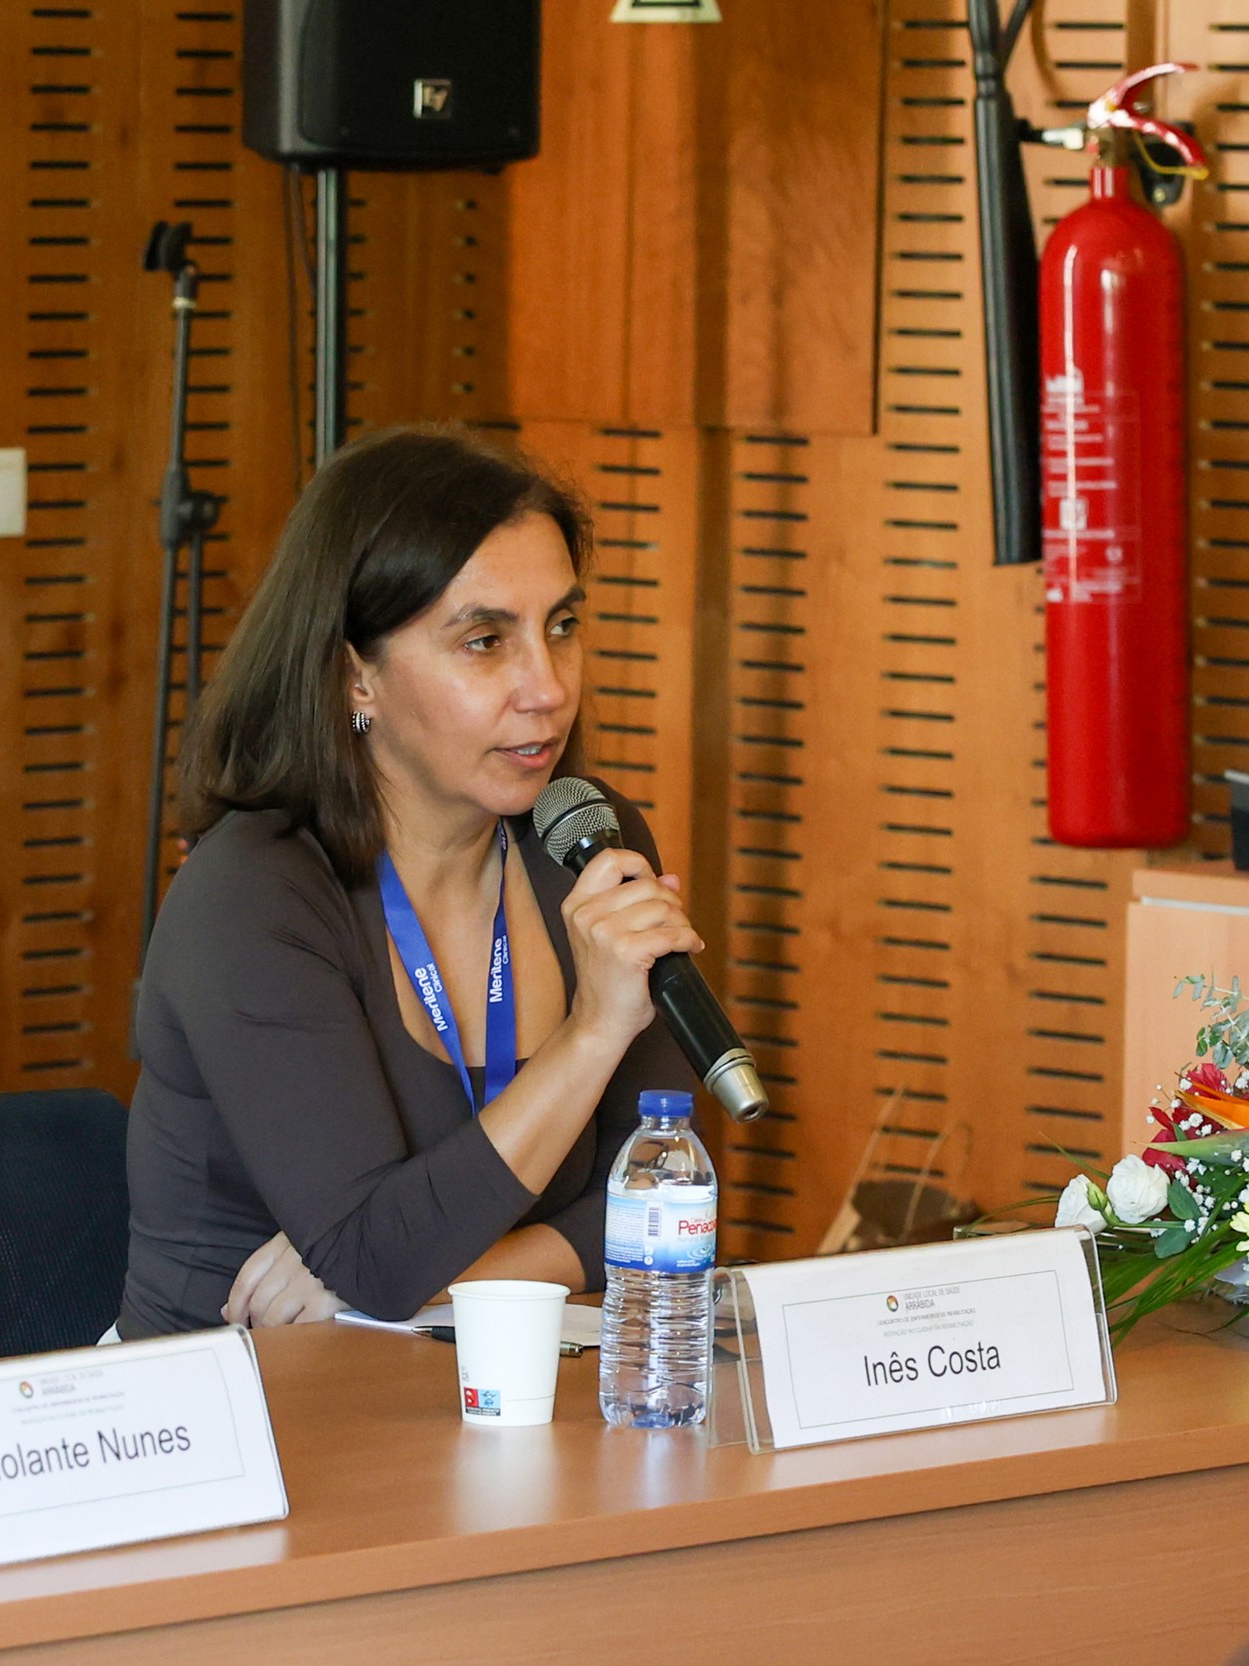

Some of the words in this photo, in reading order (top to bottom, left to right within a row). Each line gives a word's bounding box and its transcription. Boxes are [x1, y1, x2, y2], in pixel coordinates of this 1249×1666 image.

[426, 963, 443, 992] Clinical
[489, 938, 502, 1003] Meritene
[414, 967, 448, 1032] Meritene
[864, 1351, 919, 1386] Inês
[927, 1341, 1001, 1378] Costa
[97, 1425, 191, 1464] Nunes
